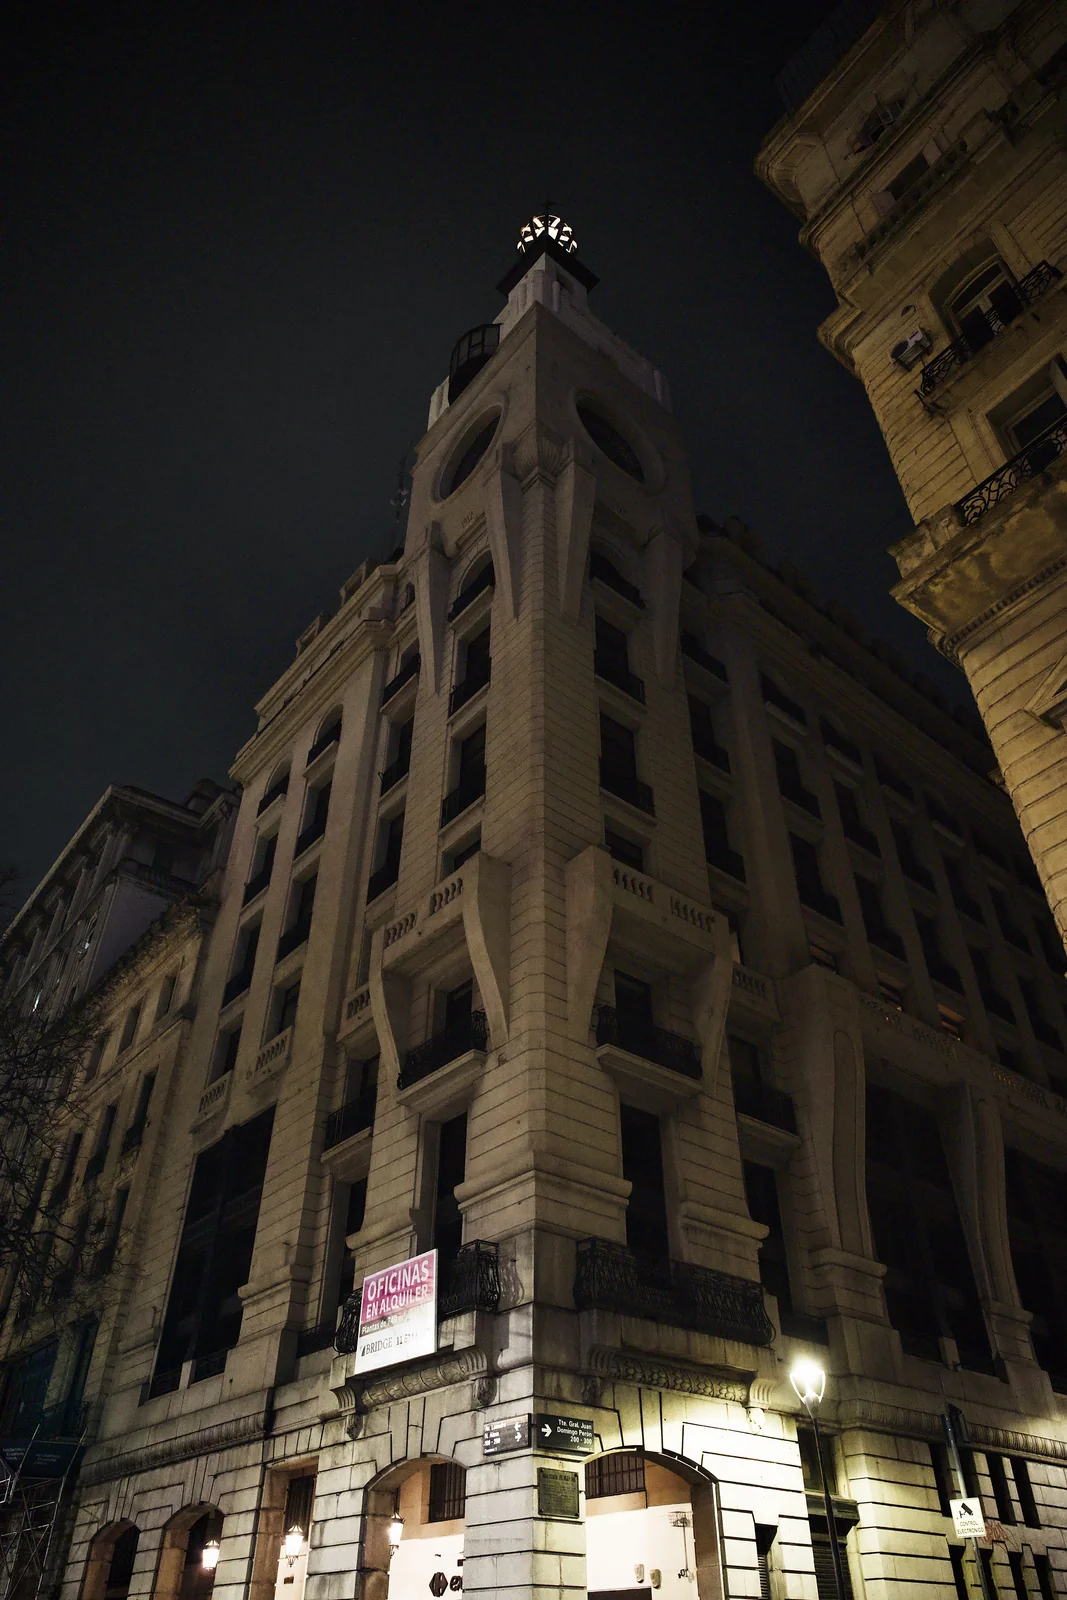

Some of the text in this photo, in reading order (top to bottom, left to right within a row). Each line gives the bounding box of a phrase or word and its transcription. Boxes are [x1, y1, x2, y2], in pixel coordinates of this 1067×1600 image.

[367, 1259, 429, 1301] OFICINAS
[366, 1301, 378, 1319] EN
[379, 1284, 429, 1315] ALQUILER
[361, 1322, 380, 1334] Plantas
[366, 1337, 393, 1355] BRIDGE
[558, 1418, 568, 1426] Tte.
[581, 1422, 592, 1430] Juan
[557, 1426, 578, 1436] Domingo
[570, 1435, 580, 1443] 200
[583, 1437, 592, 1445] 300
